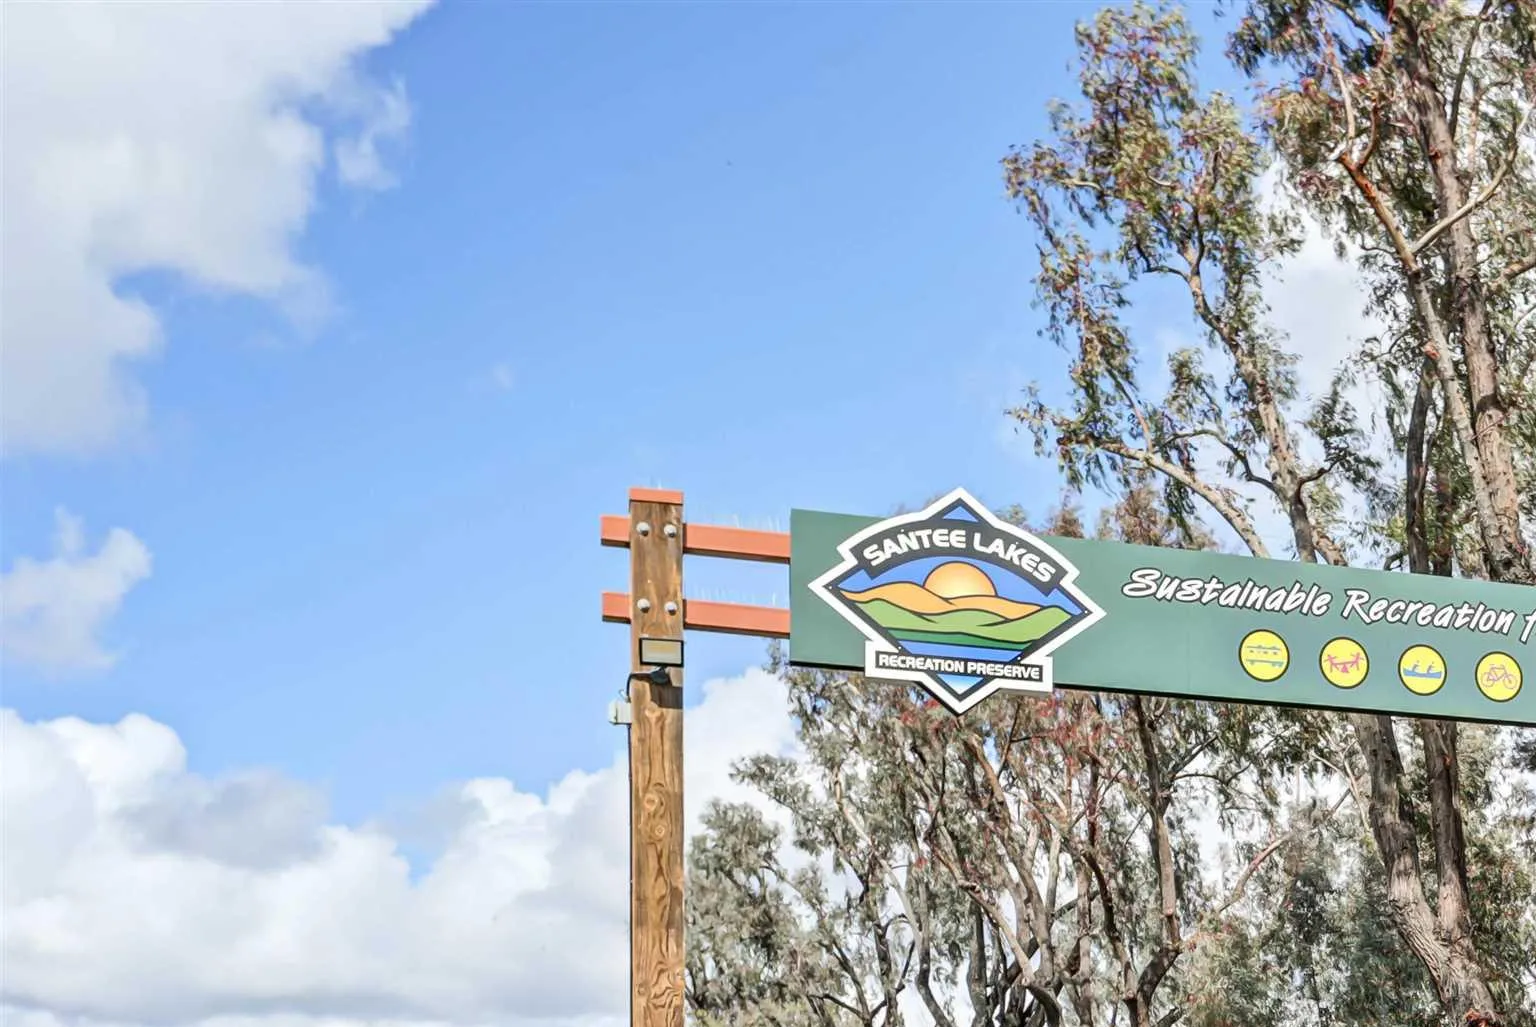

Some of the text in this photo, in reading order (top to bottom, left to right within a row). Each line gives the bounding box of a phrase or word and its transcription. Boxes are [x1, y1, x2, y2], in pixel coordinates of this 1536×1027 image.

[863, 528, 1056, 584] SANTEE LAKES
[1122, 568, 1333, 616] Sustainable
[1342, 588, 1516, 634] Recreation
[878, 654, 1040, 680] RECREATION PRESERVE
